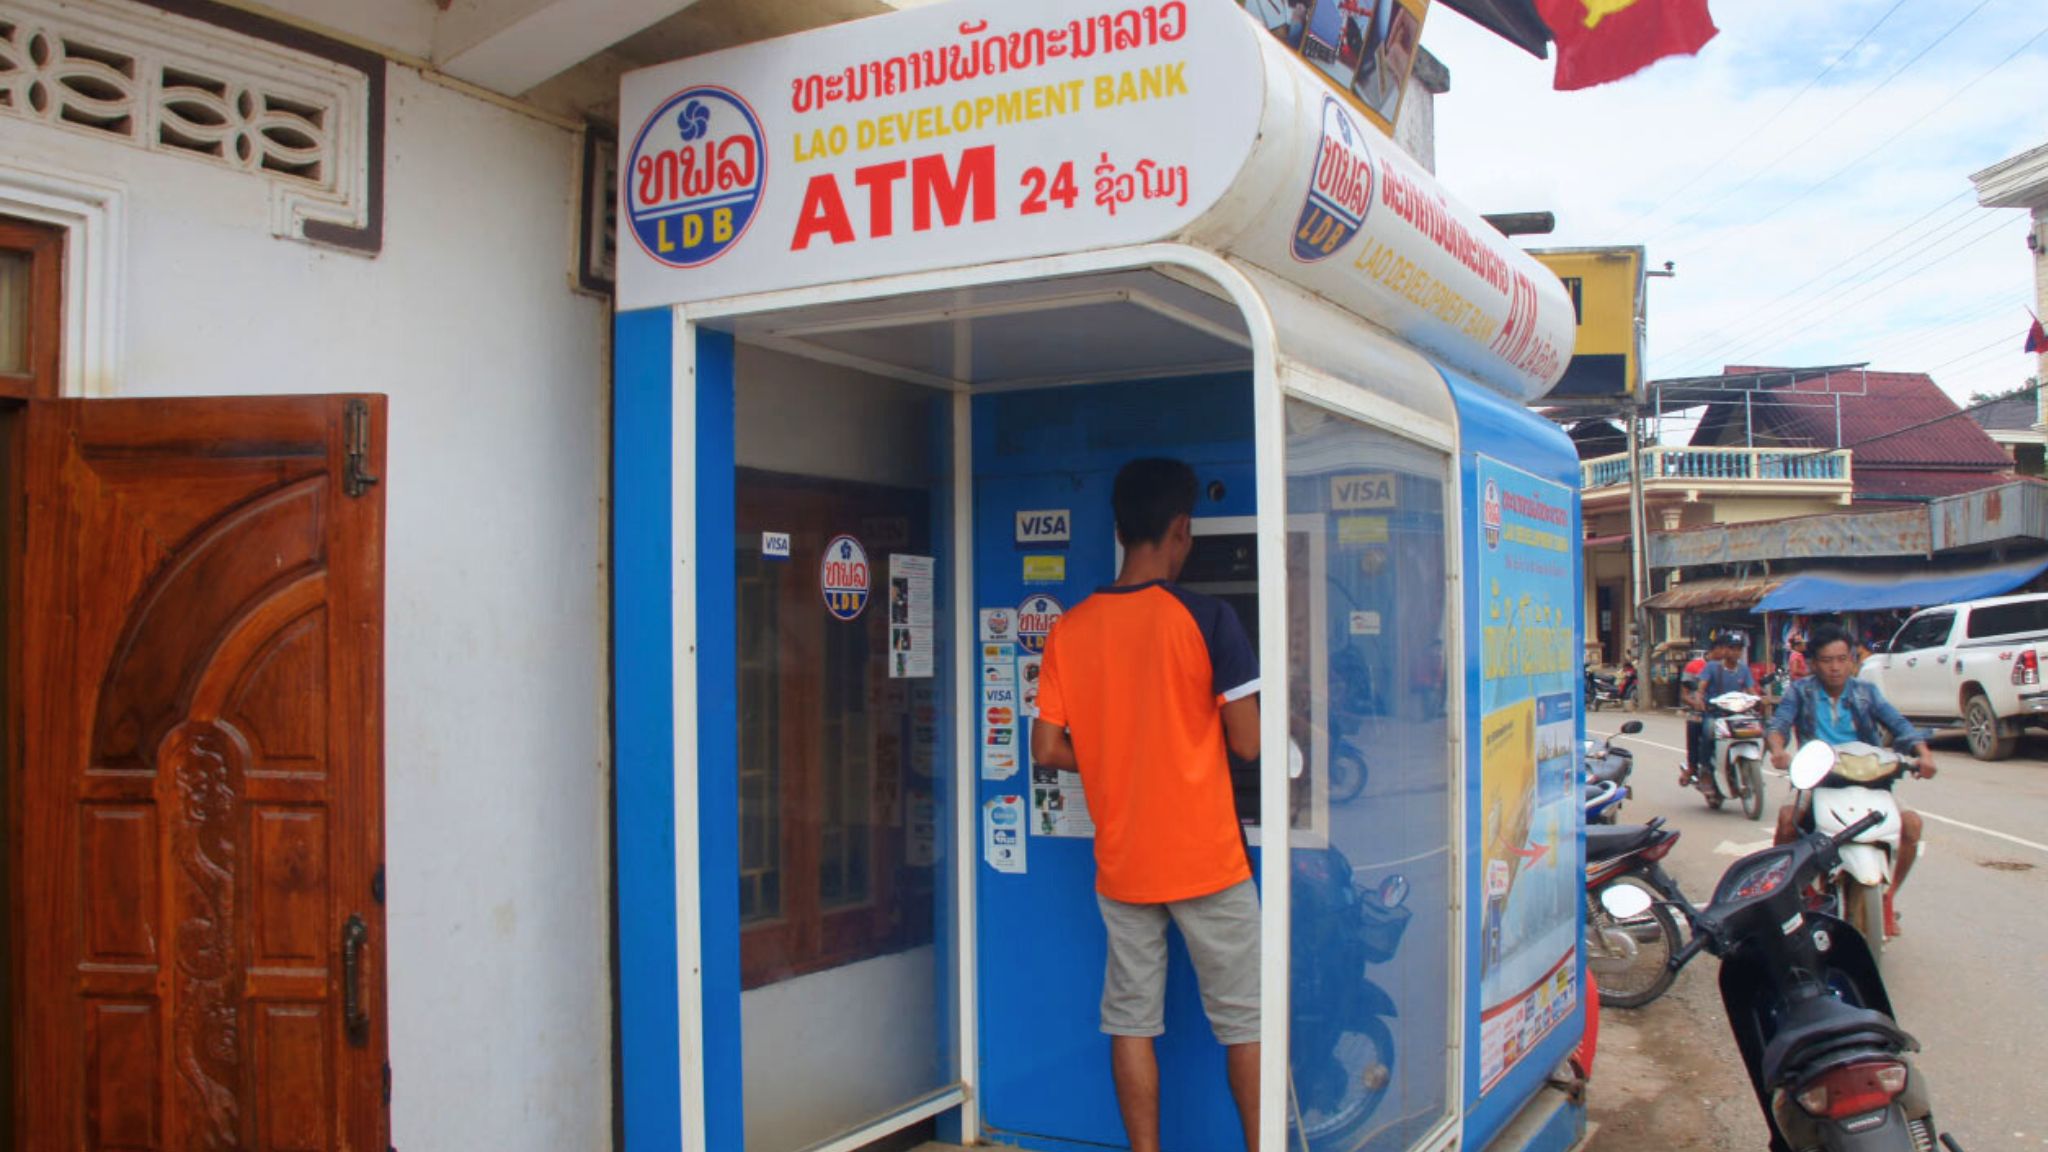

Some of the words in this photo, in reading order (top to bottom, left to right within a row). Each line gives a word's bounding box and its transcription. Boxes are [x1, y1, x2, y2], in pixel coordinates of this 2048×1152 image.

[791, 0, 1188, 113] ທະນາຄານພັດທະນາລາວ
[793, 124, 848, 163] LAO
[856, 79, 1085, 152] DEVELOPMENT
[1093, 60, 1189, 109] BANK
[637, 134, 756, 206] ທພລ
[791, 144, 996, 252] ATM
[1020, 160, 1079, 216] 24
[1094, 151, 1189, 216] ຊົ່ວໂມງ
[657, 207, 734, 253] LDB
[1297, 208, 1346, 254] LDB
[1353, 236, 1395, 280] LAO
[1382, 254, 1474, 326] DEVELOPMENT
[1461, 306, 1501, 343] BANK
[1490, 268, 1538, 365] ATM
[1337, 480, 1392, 502] VISA
[765, 537, 788, 552] VISA
[1019, 514, 1068, 536] VISA
[832, 593, 860, 611] LDB
[1026, 636, 1046, 649] LD
[986, 690, 1012, 702] VISA
